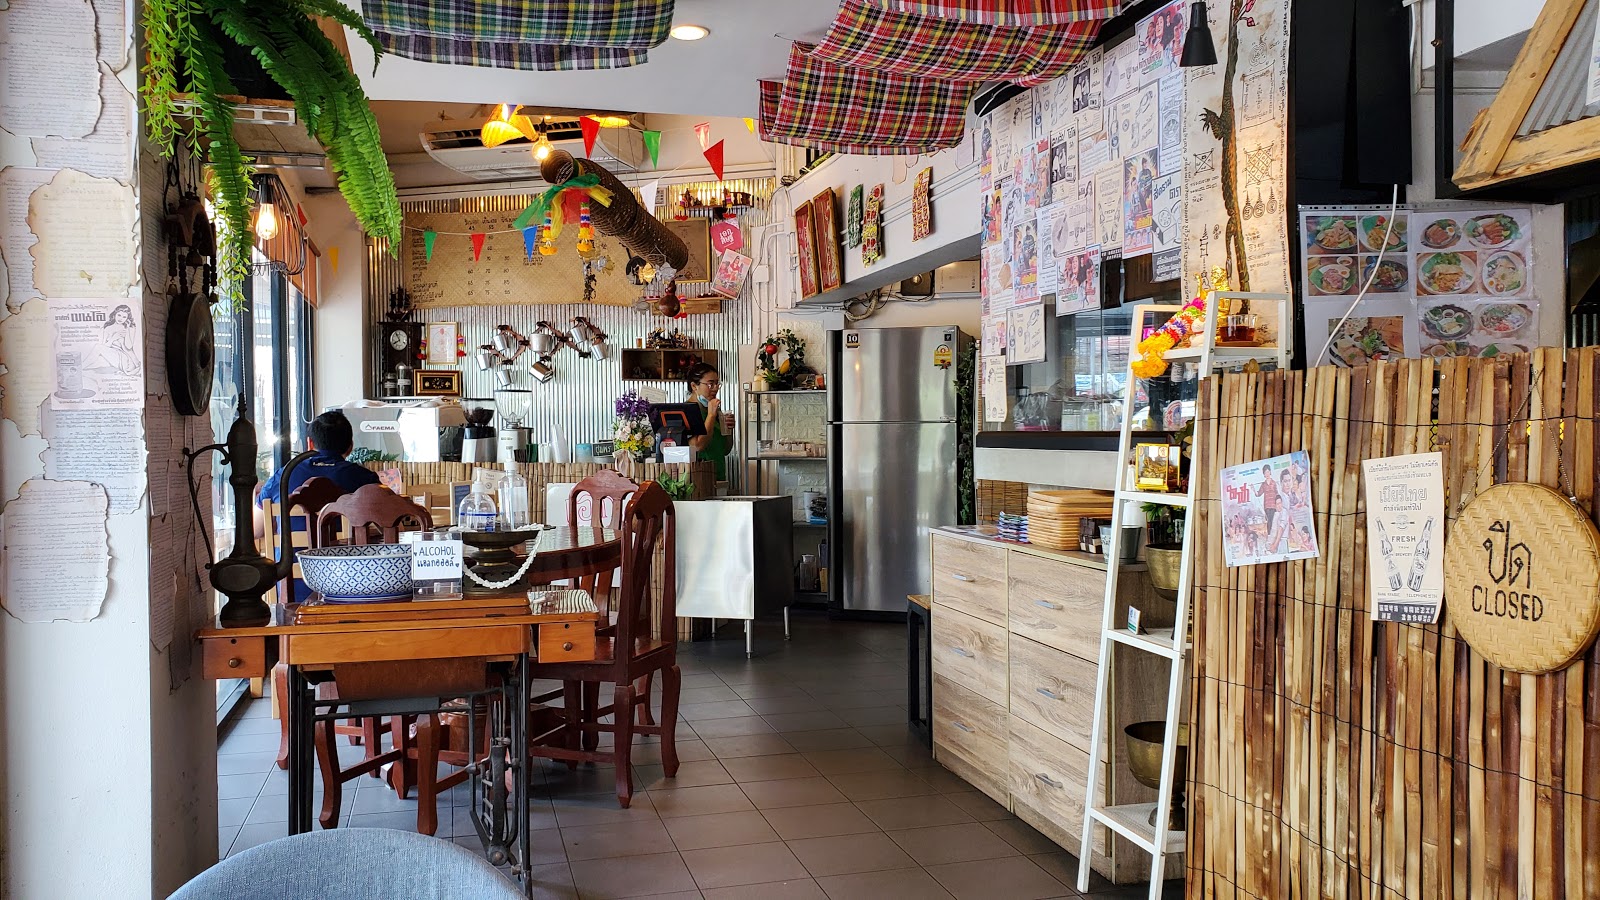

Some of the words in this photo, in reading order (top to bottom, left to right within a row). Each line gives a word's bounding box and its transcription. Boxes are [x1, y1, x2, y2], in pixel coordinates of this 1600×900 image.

[847, 334, 858, 343] 10
[1391, 535, 1416, 543] FRESH
[418, 546, 456, 557] ALCOHOL
[1482, 520, 1533, 589] ปิด
[1471, 584, 1544, 622] CLOSED
